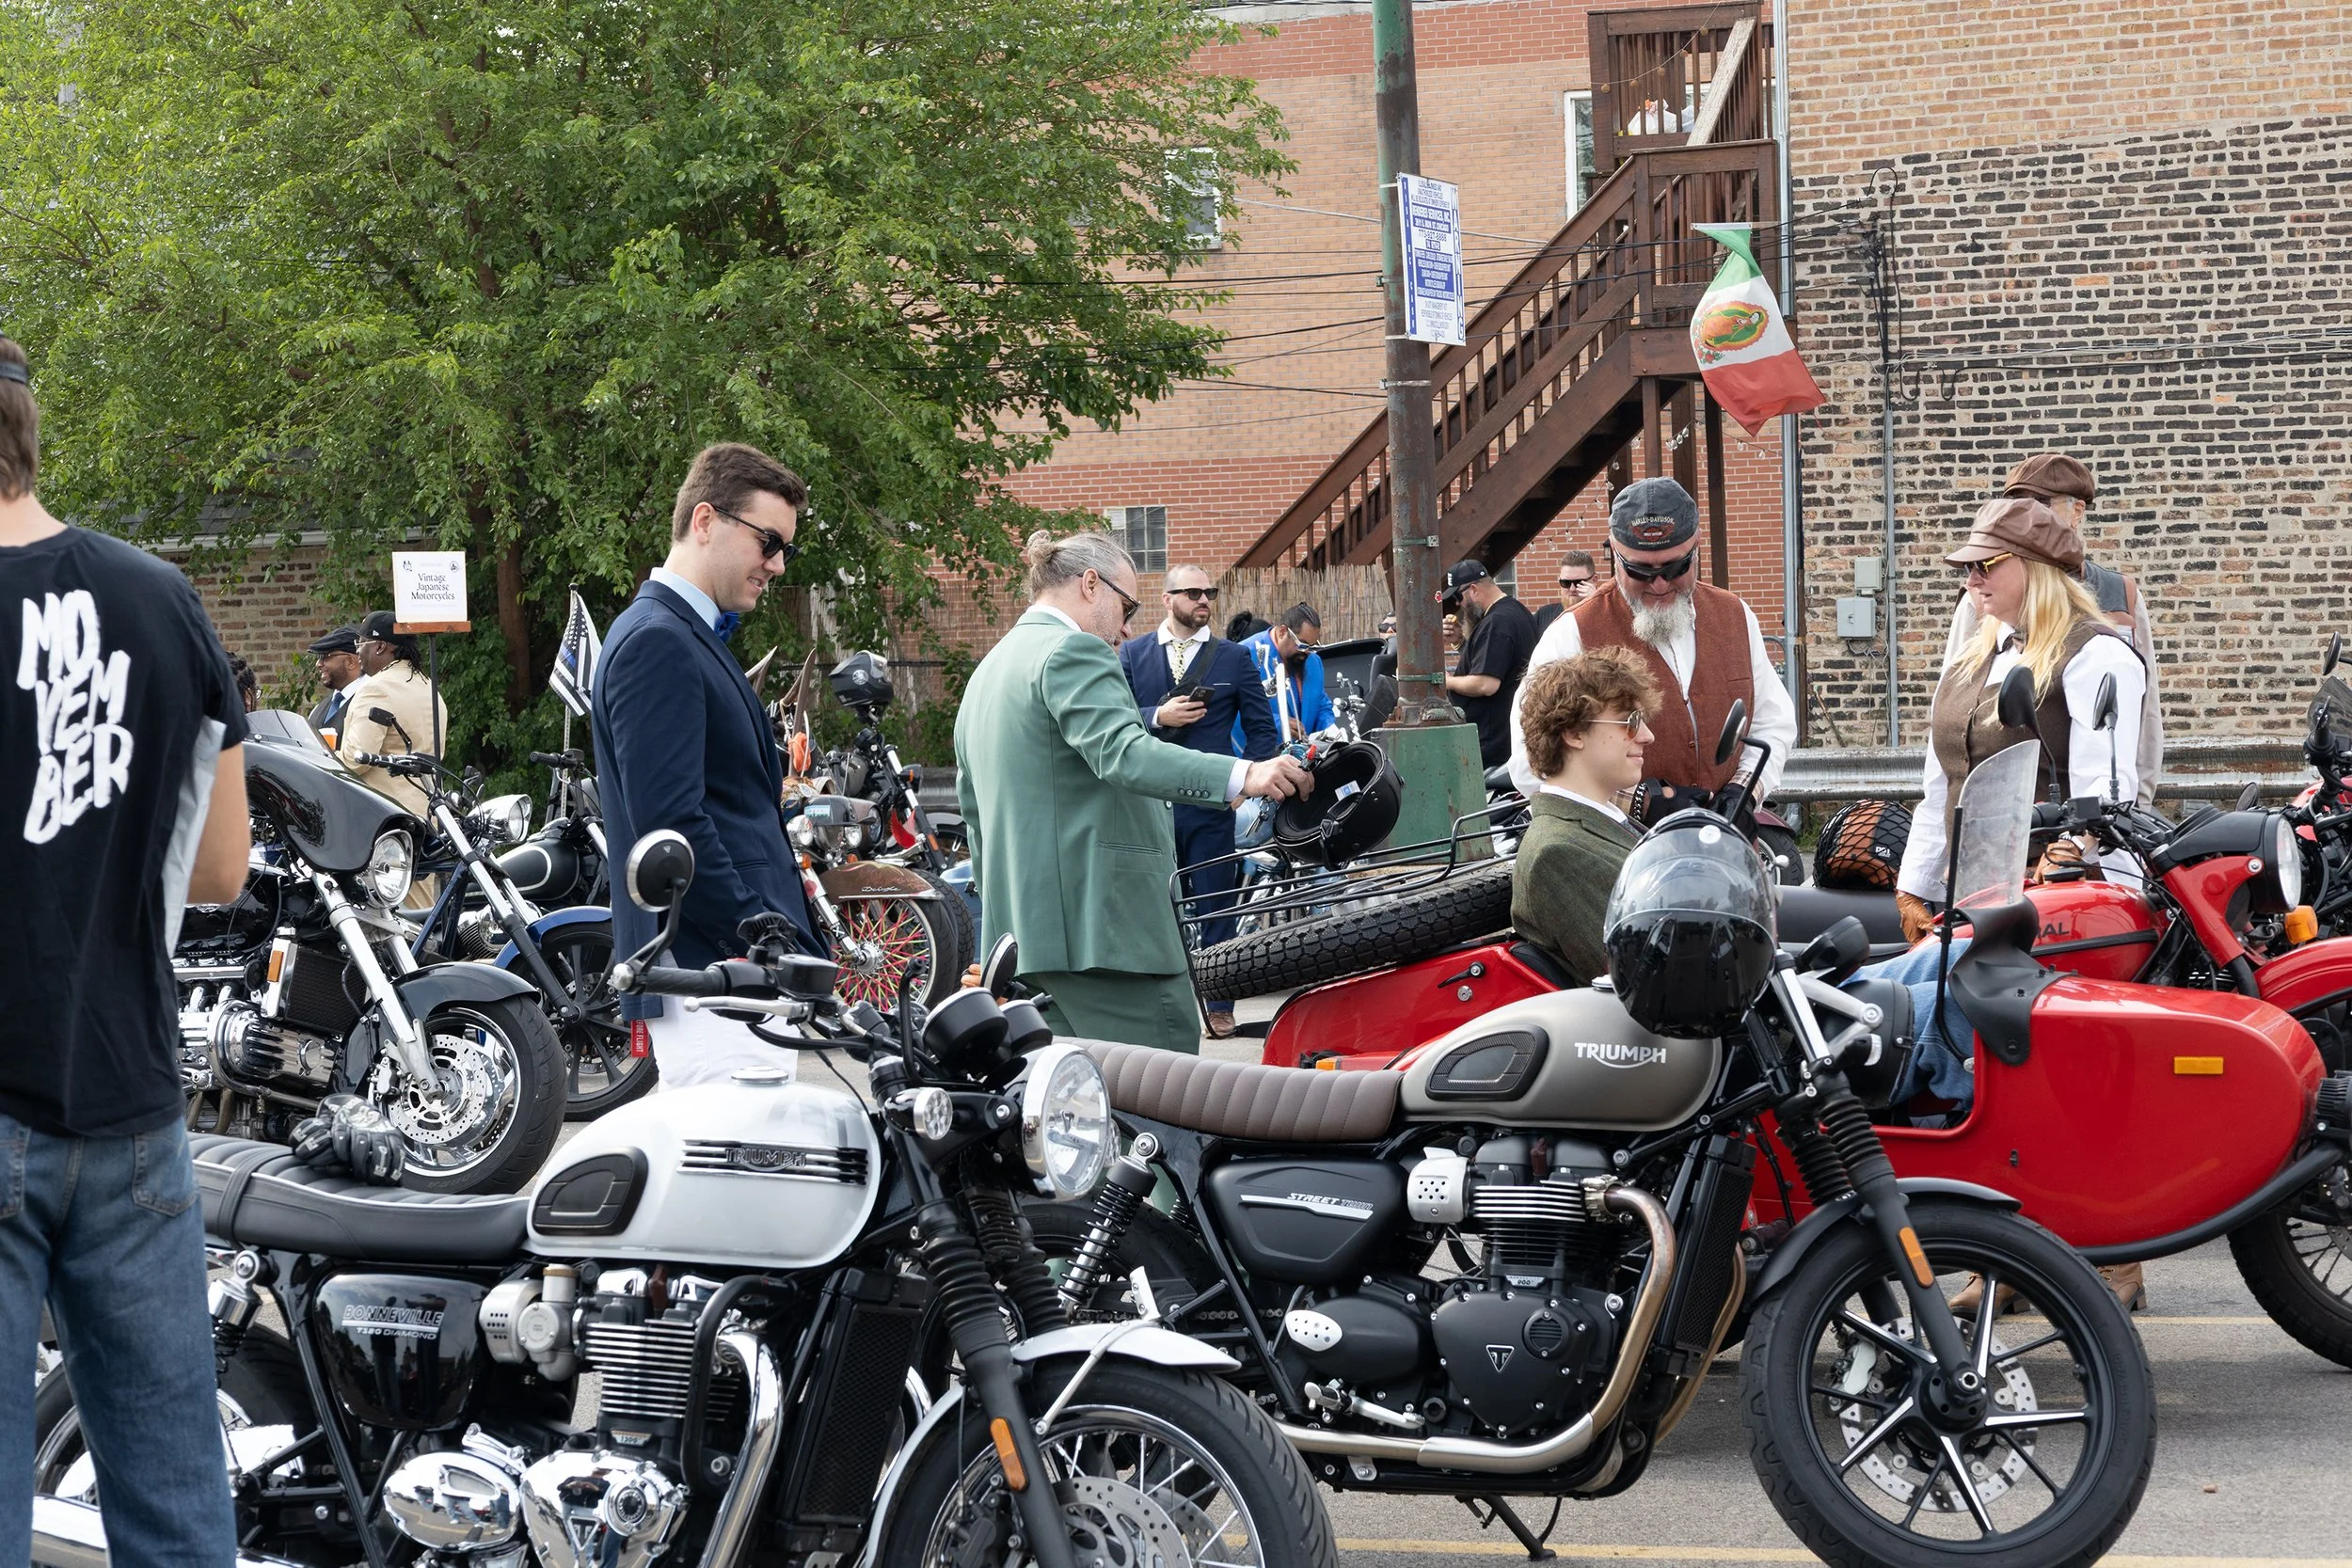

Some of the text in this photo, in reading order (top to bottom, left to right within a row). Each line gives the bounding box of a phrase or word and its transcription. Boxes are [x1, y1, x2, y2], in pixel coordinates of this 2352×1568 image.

[1451, 187, 1465, 340] WARNING
[418, 573, 446, 583] Vintage
[417, 582, 450, 593] Japanese
[411, 592, 455, 602] Motorcycles
[2037, 922, 2070, 939] AL
[636, 1034, 644, 1053] FLIGHT
[1574, 1042, 1666, 1069] TRIUMPH
[724, 1148, 807, 1172] TRIUMPH
[1287, 1192, 1340, 1205] STREET
[342, 1305, 445, 1326] BONNEVILLE
[383, 1329, 437, 1340] DIAMOND
